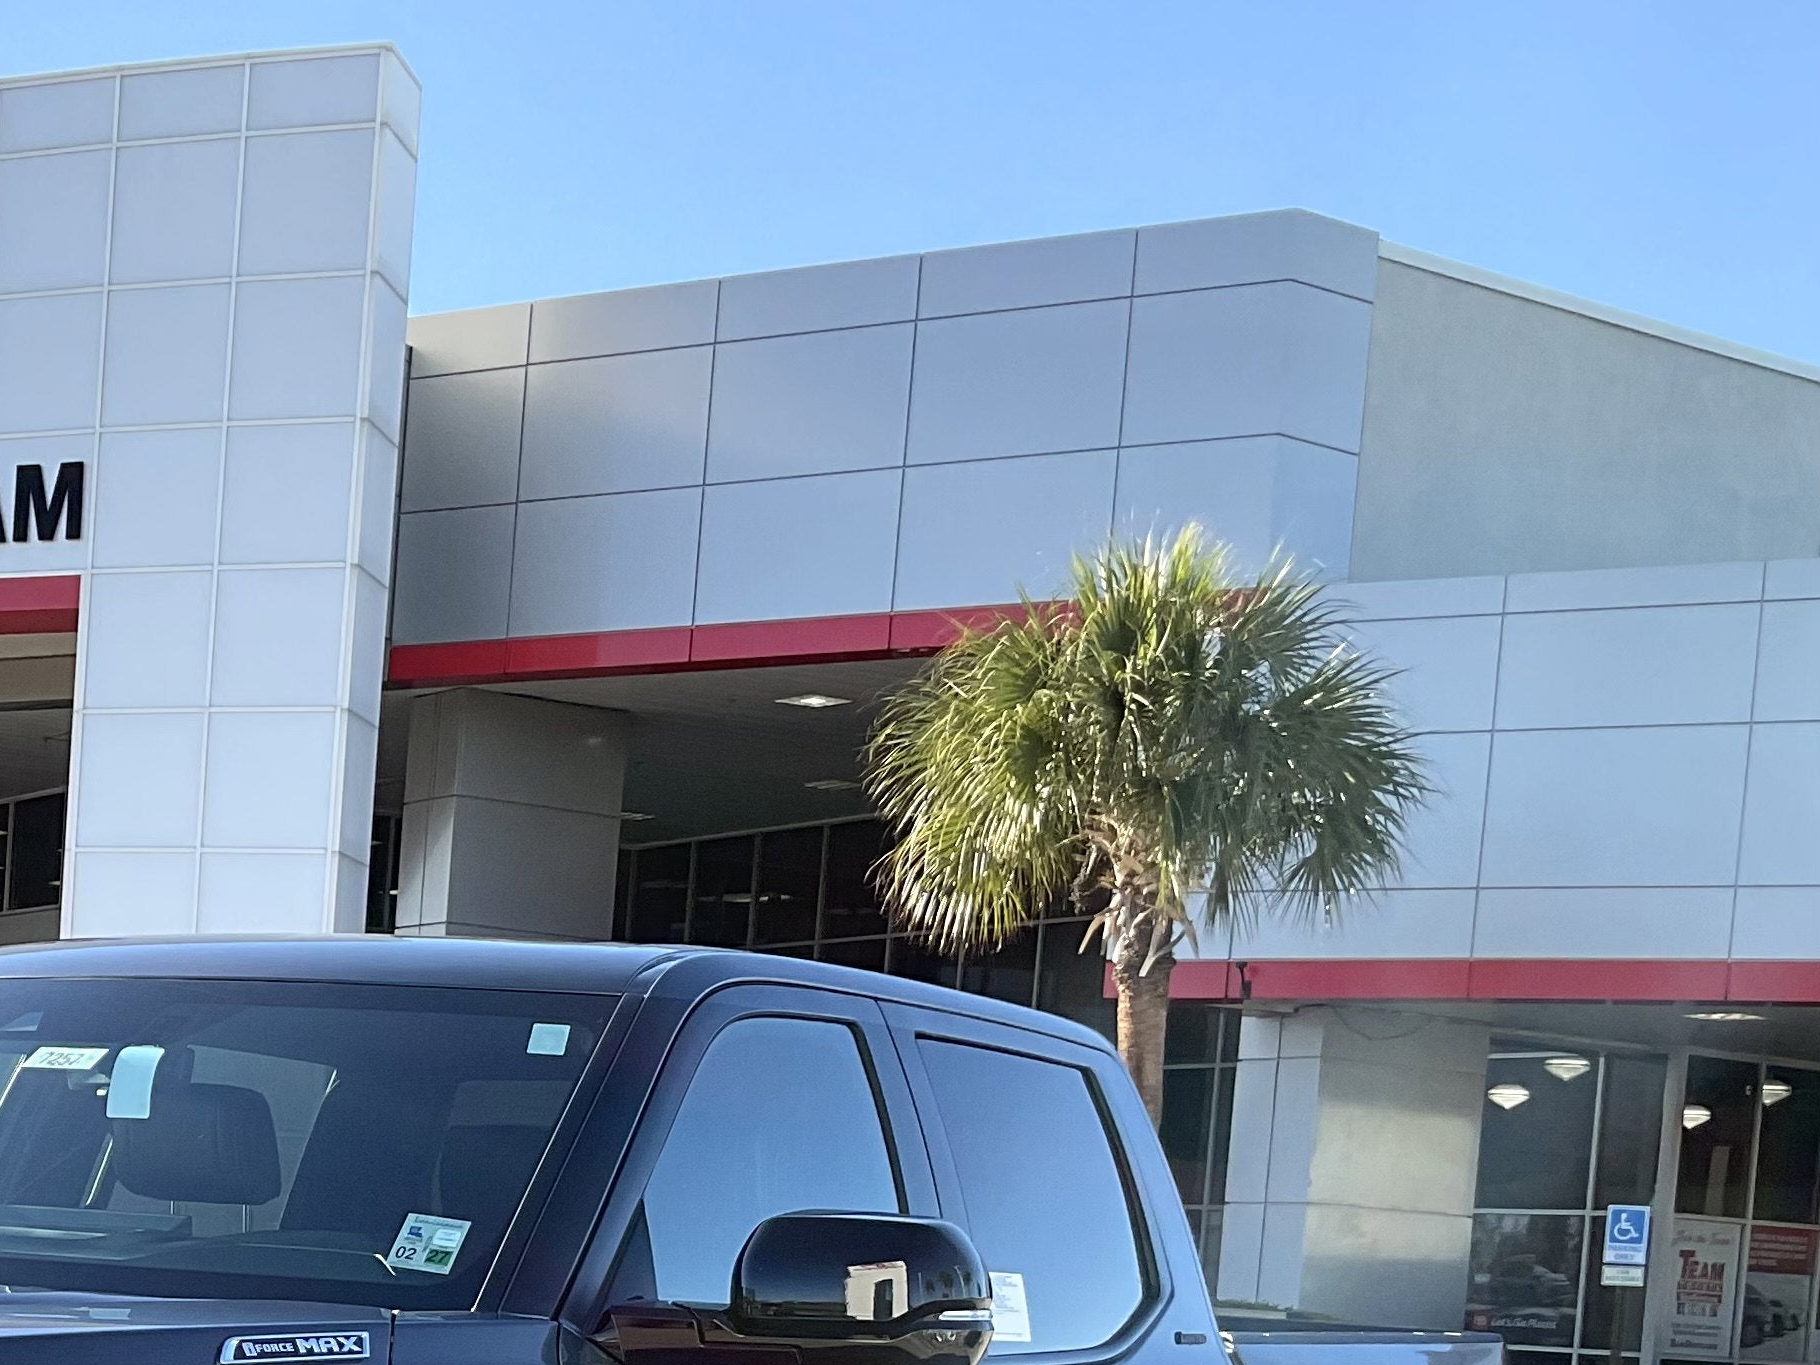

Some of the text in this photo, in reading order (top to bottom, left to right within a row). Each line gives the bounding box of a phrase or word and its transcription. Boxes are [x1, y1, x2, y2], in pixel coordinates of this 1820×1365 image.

[395, 1246, 417, 1260] 02
[425, 1249, 452, 1263] 27
[295, 1336, 363, 1354] MAX
